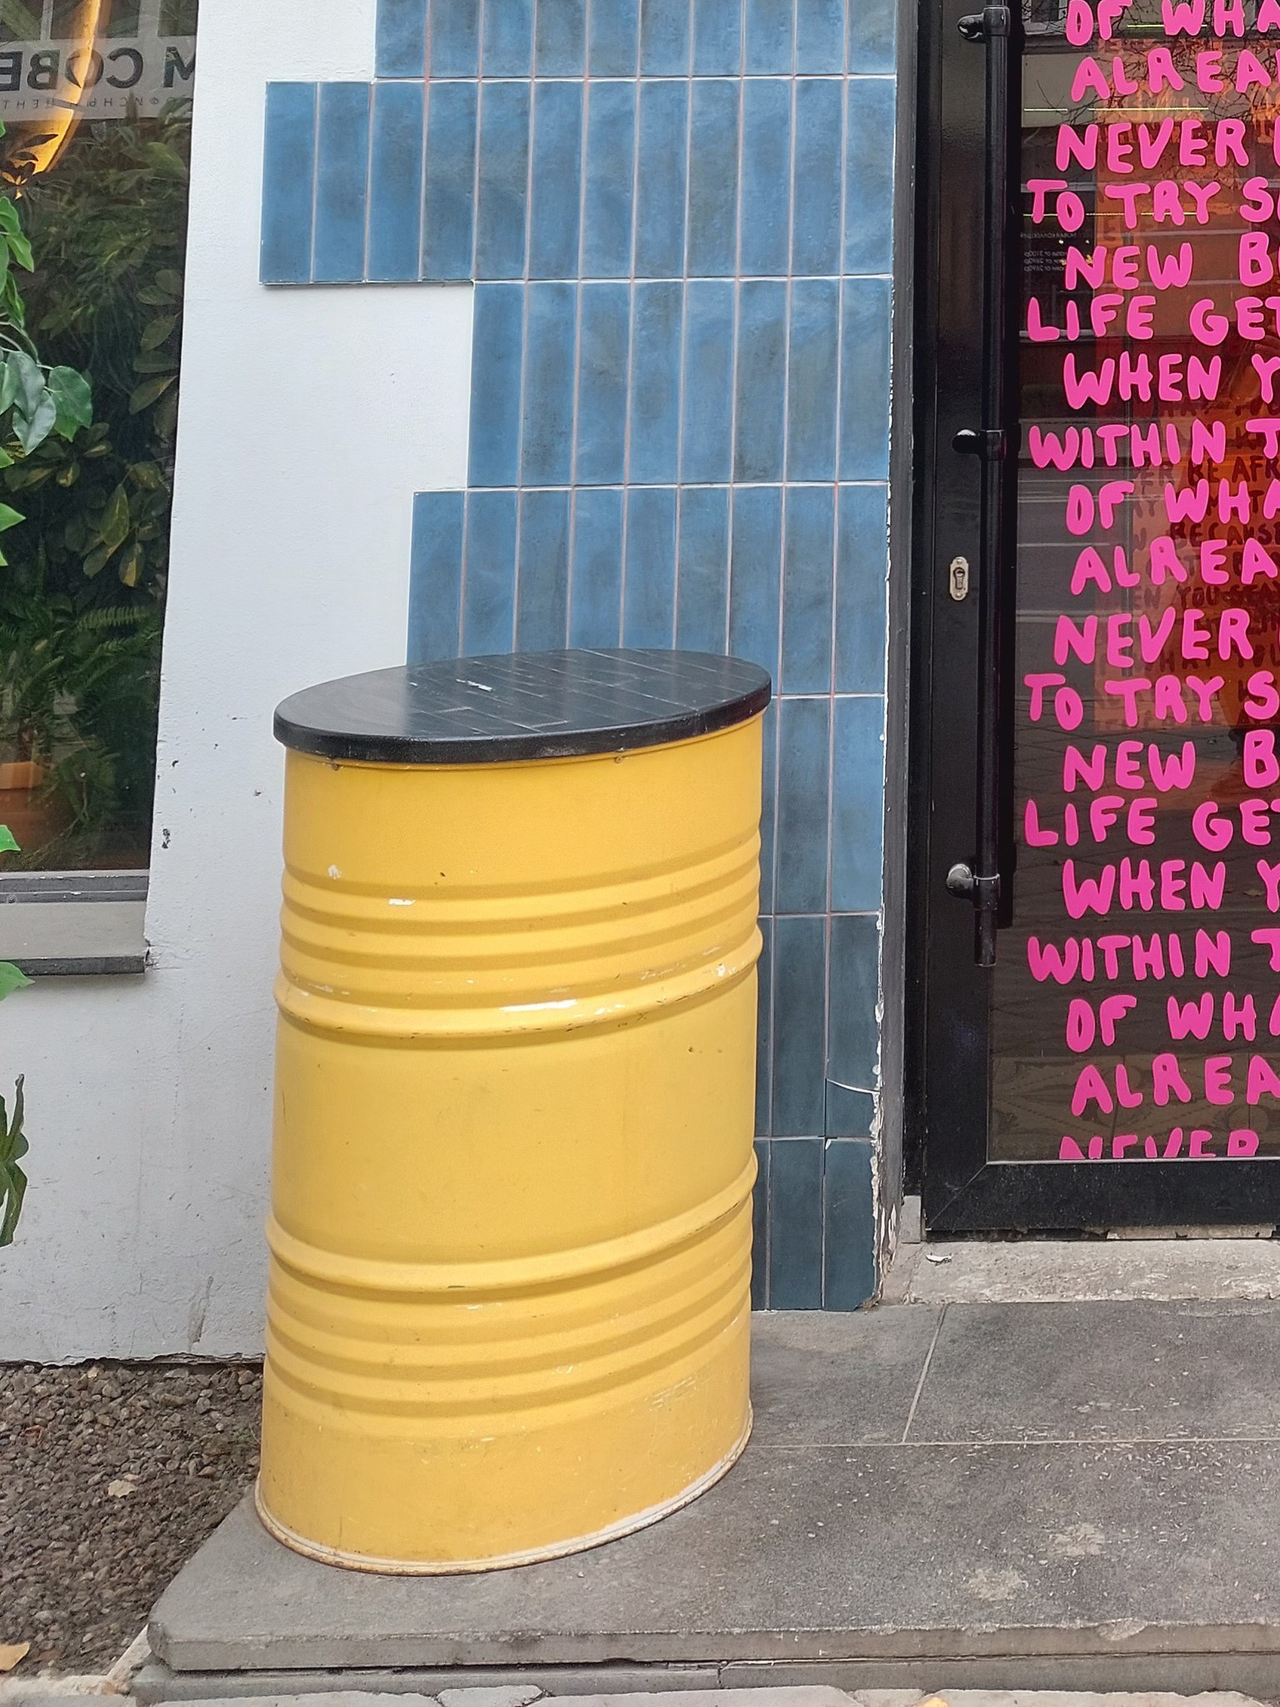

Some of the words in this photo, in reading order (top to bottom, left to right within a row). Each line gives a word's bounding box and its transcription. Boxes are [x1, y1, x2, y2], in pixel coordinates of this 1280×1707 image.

[1056, 117, 1249, 173] NEVER
[1026, 179, 1084, 232] TO
[1104, 180, 1220, 228] TRY
[1065, 243, 1193, 290] NEW
[1027, 292, 1156, 342] LIFE
[1063, 351, 1222, 409] WHEN
[1029, 419, 1226, 471] WITHIN
[1066, 481, 1135, 536] OF
[1053, 607, 1254, 669] NEVER
[1023, 673, 1084, 731] TO
[1104, 675, 1224, 728] TRY
[1062, 740, 1196, 792] NEW
[1024, 795, 1157, 847] LIFE
[1062, 857, 1226, 919] WHEN
[1027, 929, 1231, 984] WITHIN
[1066, 994, 1137, 1052] OF
